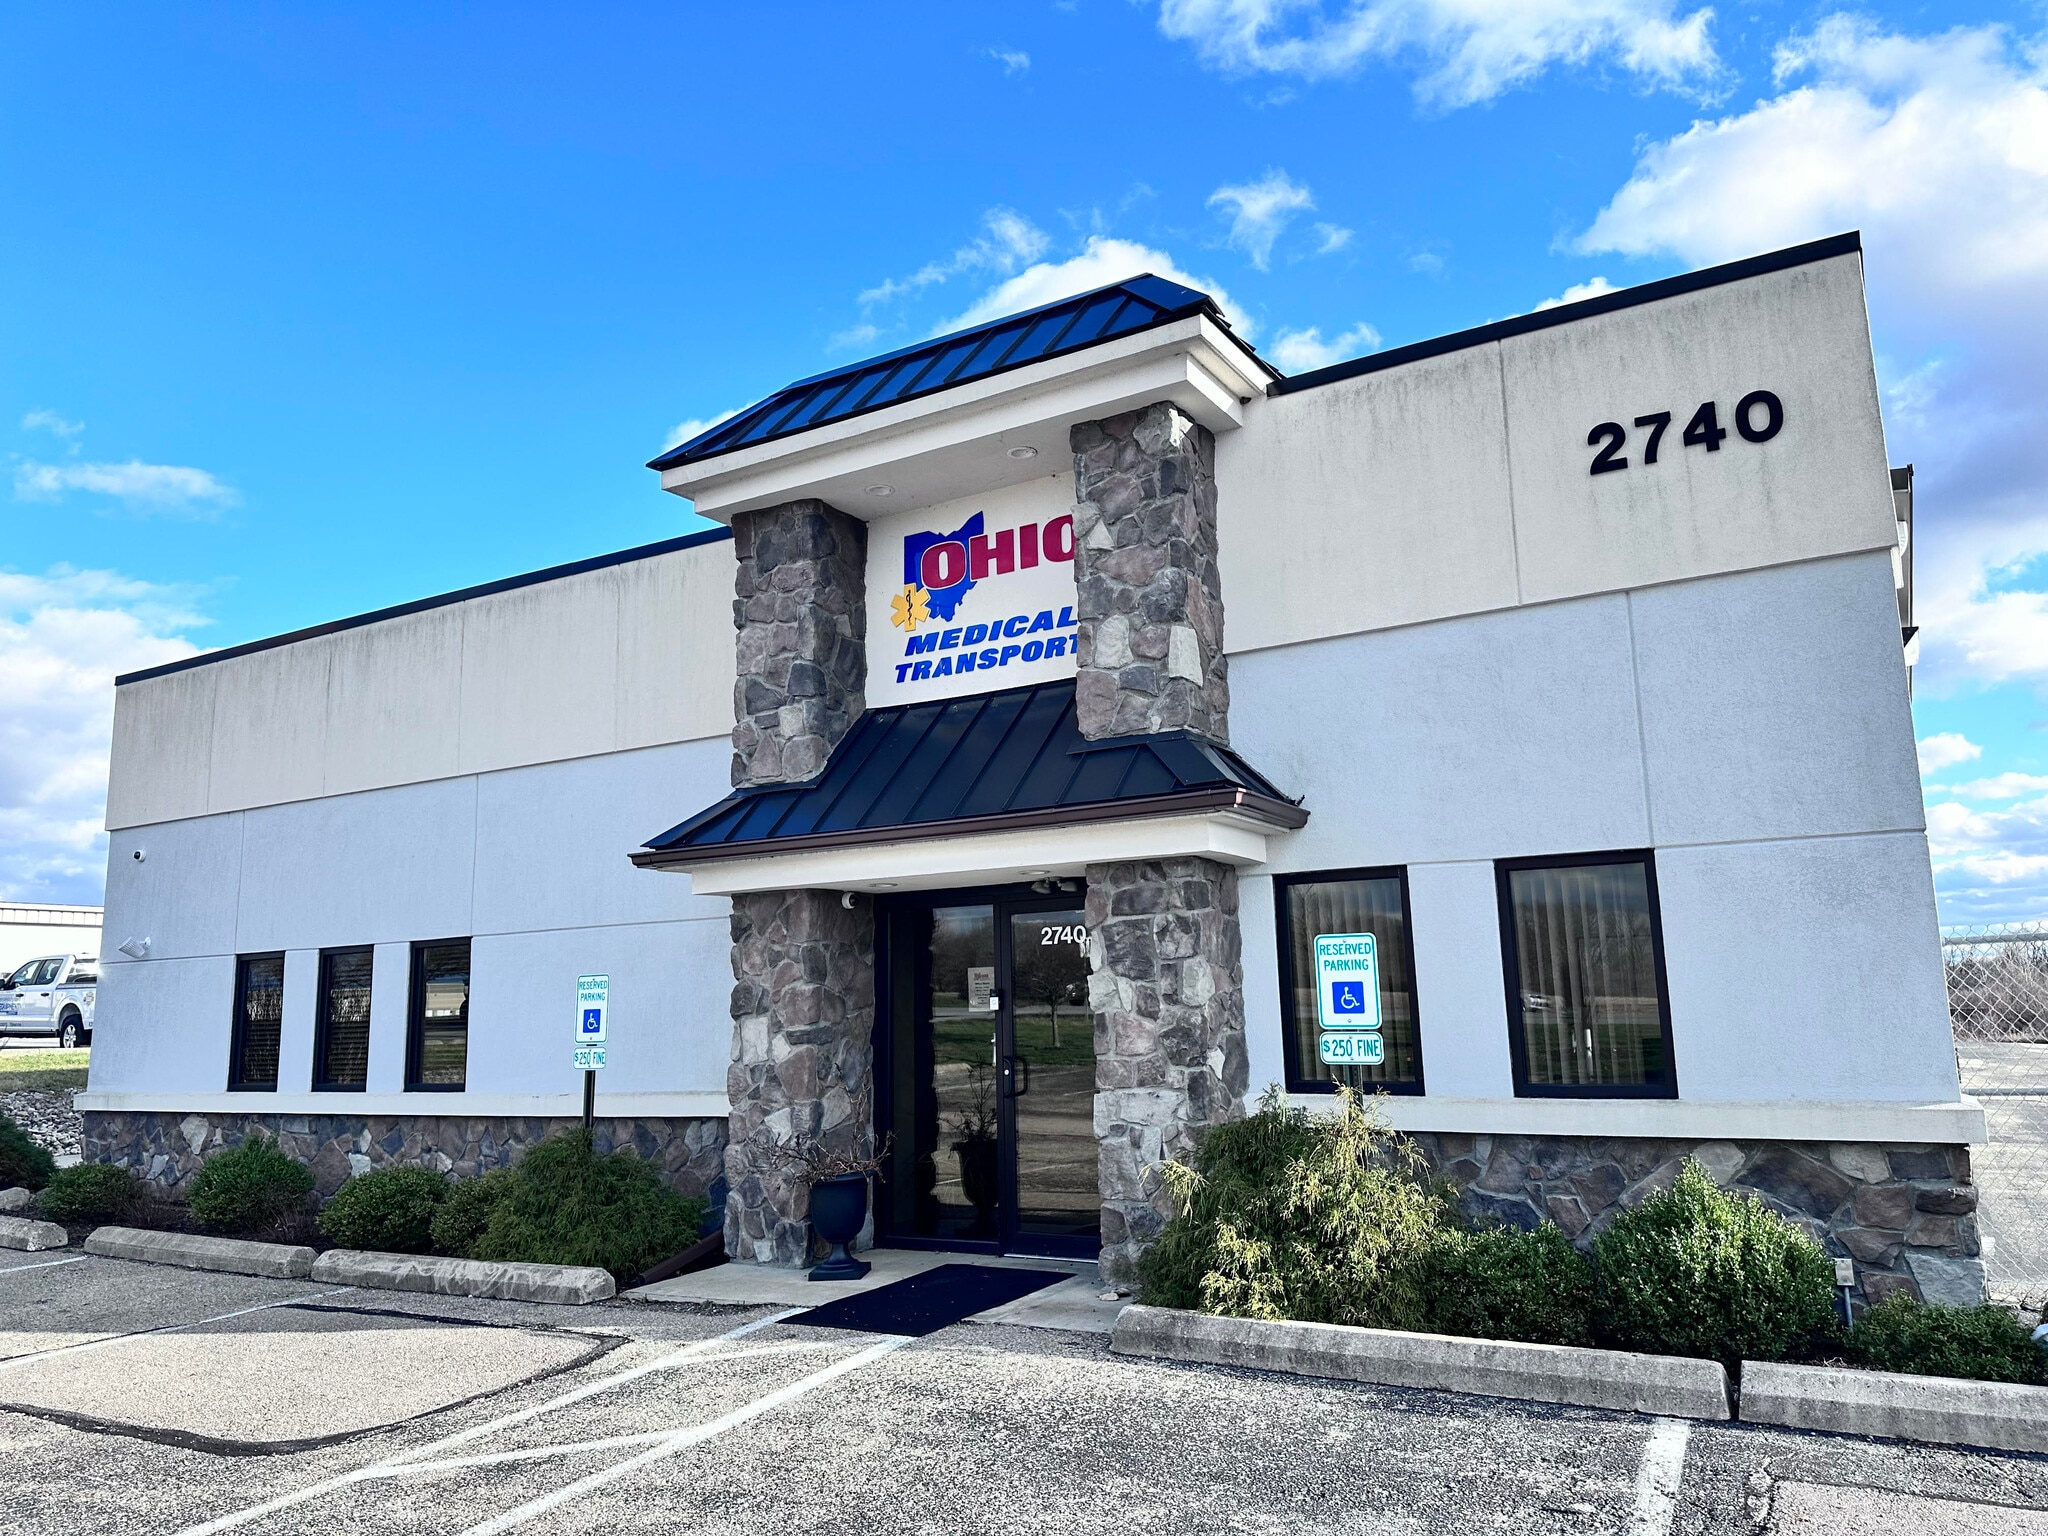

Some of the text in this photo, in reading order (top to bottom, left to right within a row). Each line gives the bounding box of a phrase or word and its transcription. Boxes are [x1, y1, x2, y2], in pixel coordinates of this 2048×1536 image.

[1587, 390, 1784, 475] 2740
[921, 514, 1076, 589] OHIO
[904, 606, 1078, 657] MEDICAL
[1041, 925, 1086, 945] 2740
[1319, 942, 1372, 956] RESERVED
[1323, 958, 1369, 971] PARKING
[579, 980, 608, 990] RESERVED
[580, 992, 606, 1001] PARKING
[1323, 1039, 1381, 1057] $250 FINE
[574, 1051, 606, 1065] $250 FINE
